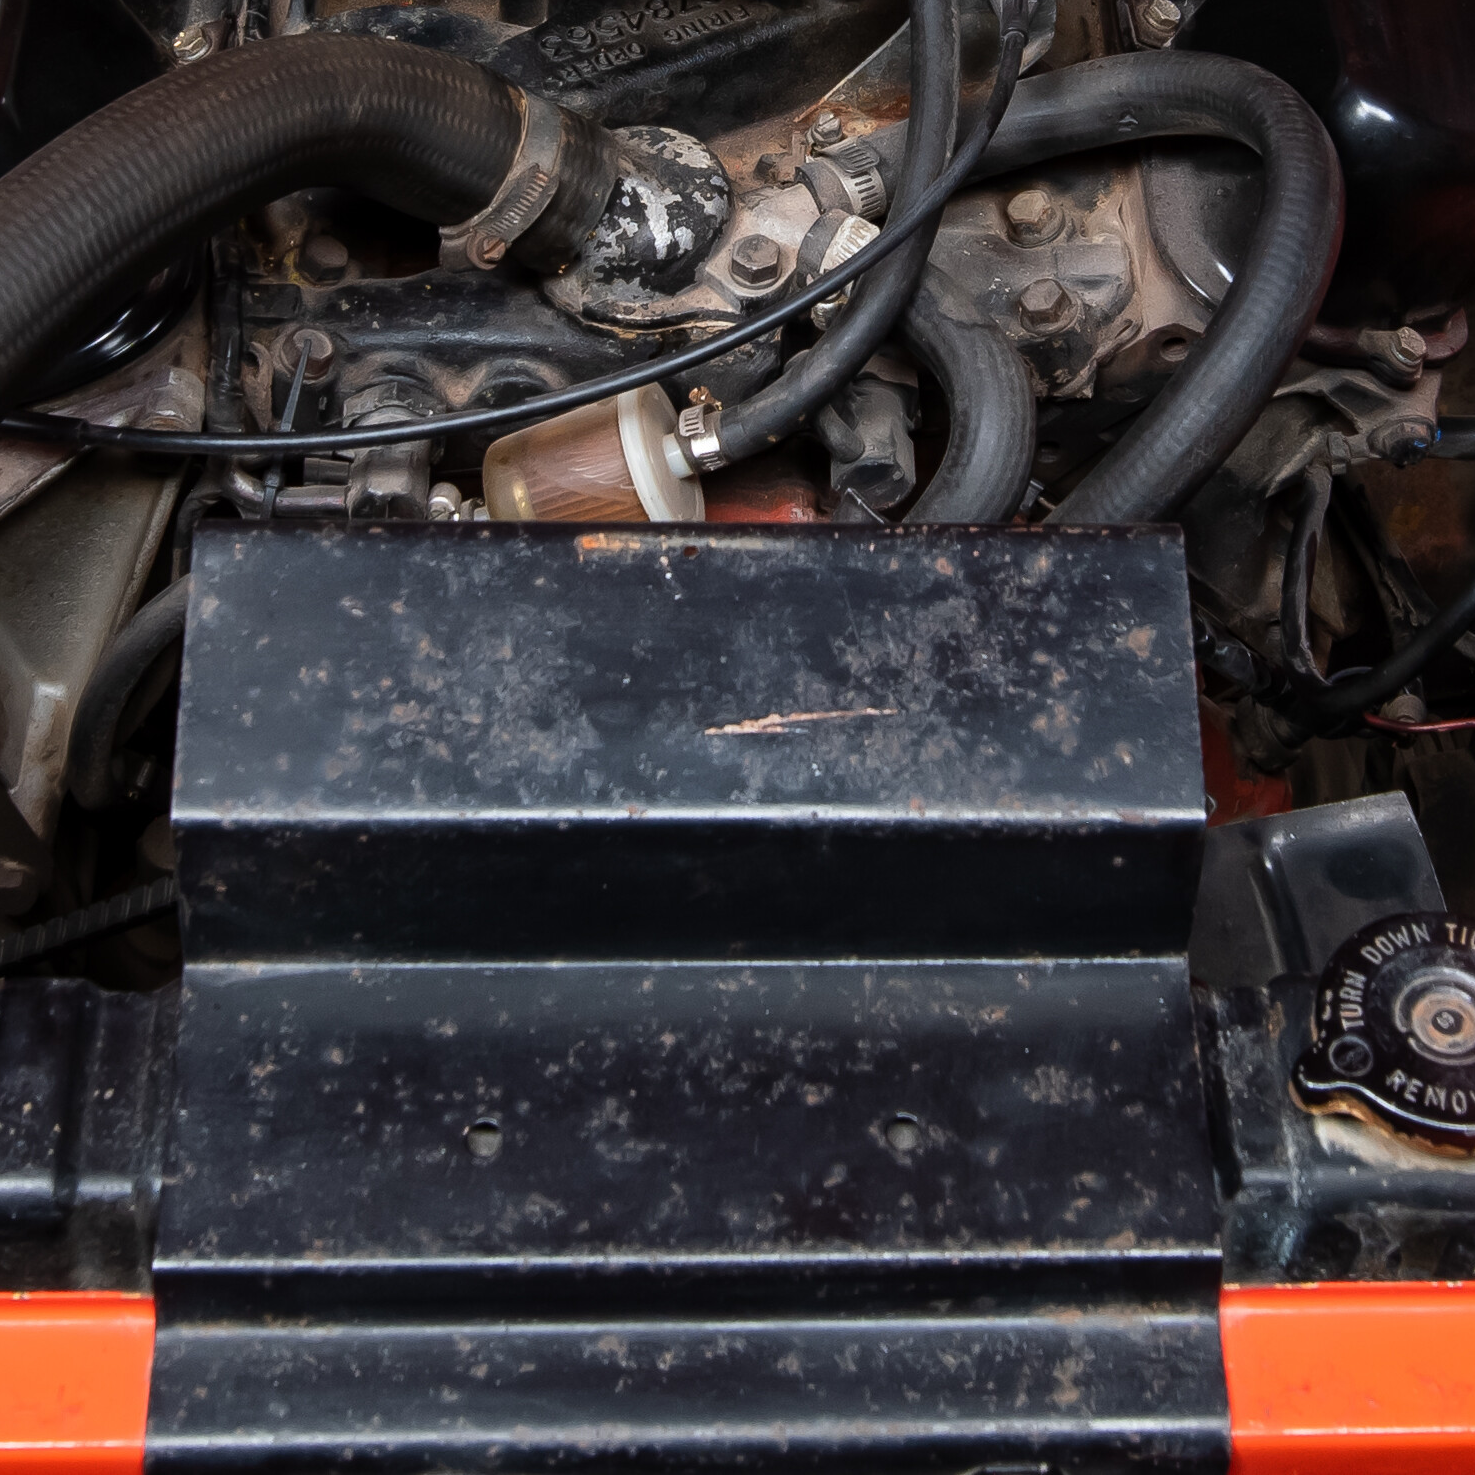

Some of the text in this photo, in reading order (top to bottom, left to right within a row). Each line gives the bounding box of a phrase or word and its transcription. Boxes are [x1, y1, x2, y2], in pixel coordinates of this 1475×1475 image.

[561, 3, 751, 83] FIRING ORDER
[1337, 968, 1368, 1032] TURN
[1360, 921, 1432, 966] DOWN
